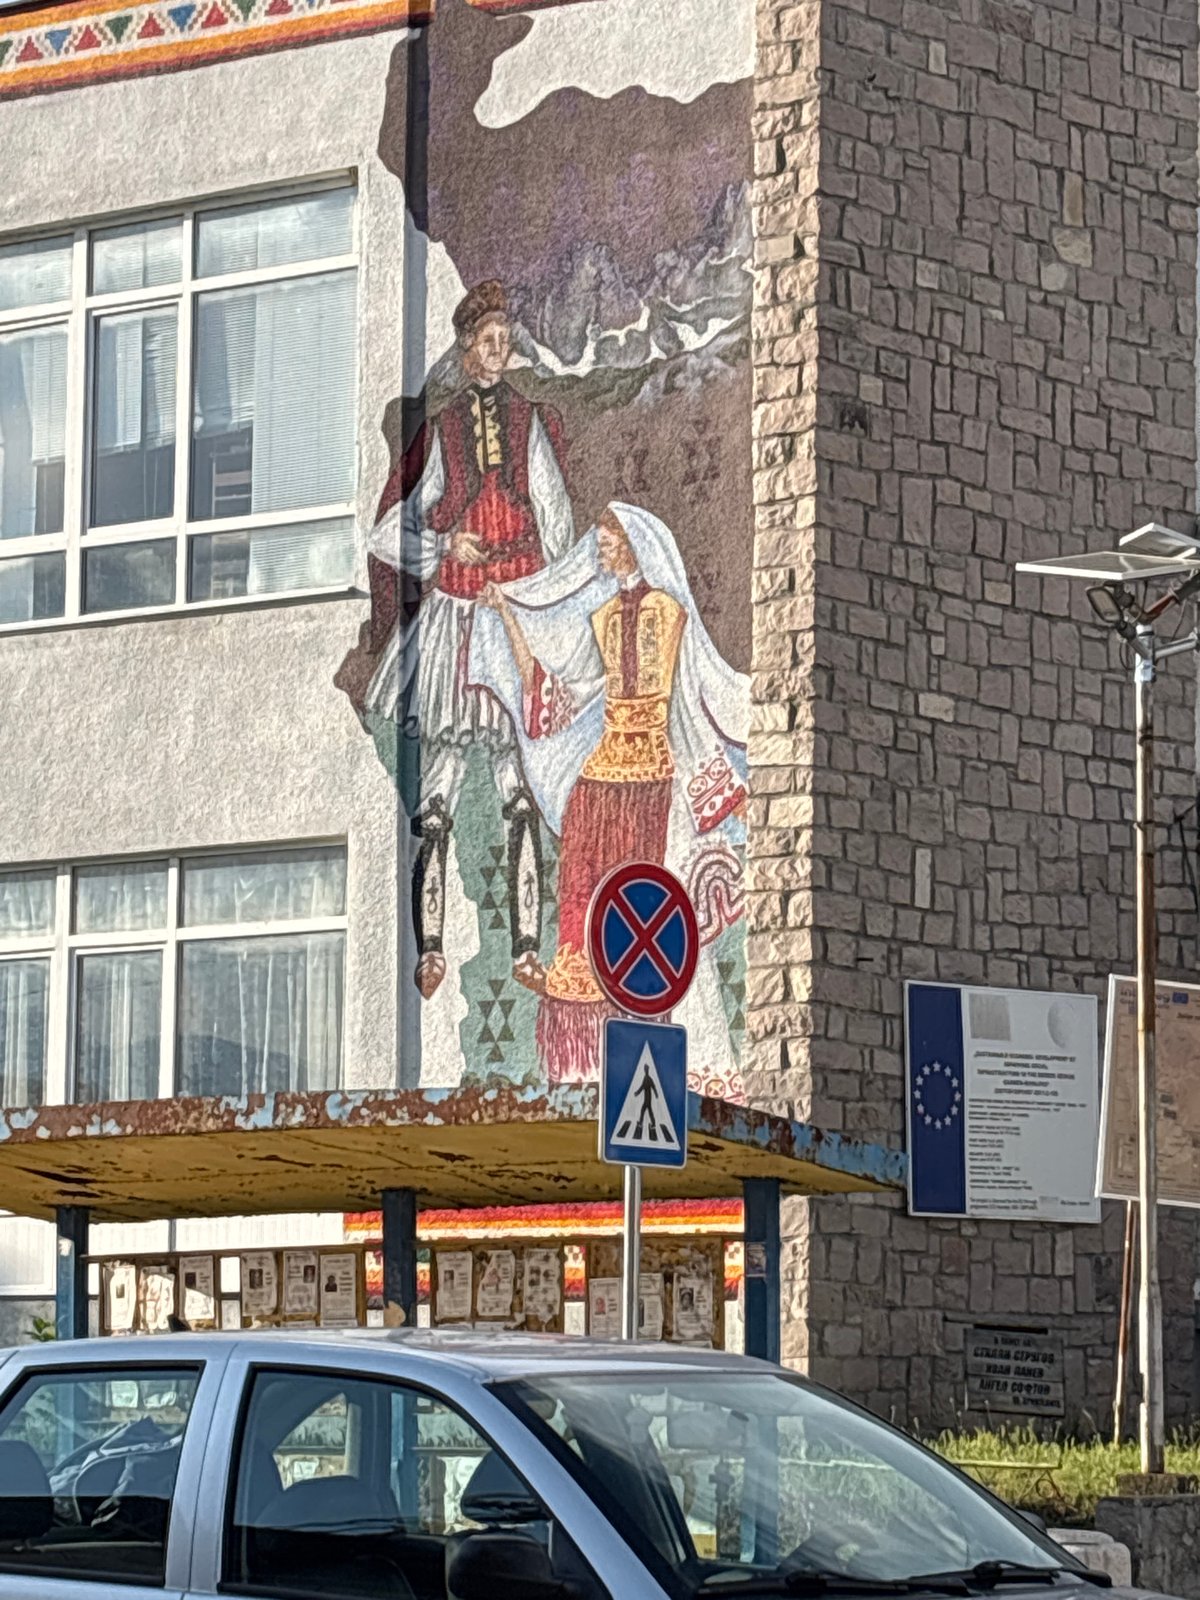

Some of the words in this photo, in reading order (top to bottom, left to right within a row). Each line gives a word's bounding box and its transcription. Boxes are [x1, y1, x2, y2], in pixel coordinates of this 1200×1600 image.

[986, 1363, 1011, 1376] ИВАН
[979, 1378, 1008, 1393] АНГЕЛ
[1011, 1381, 1051, 1395] СОФТОВ
